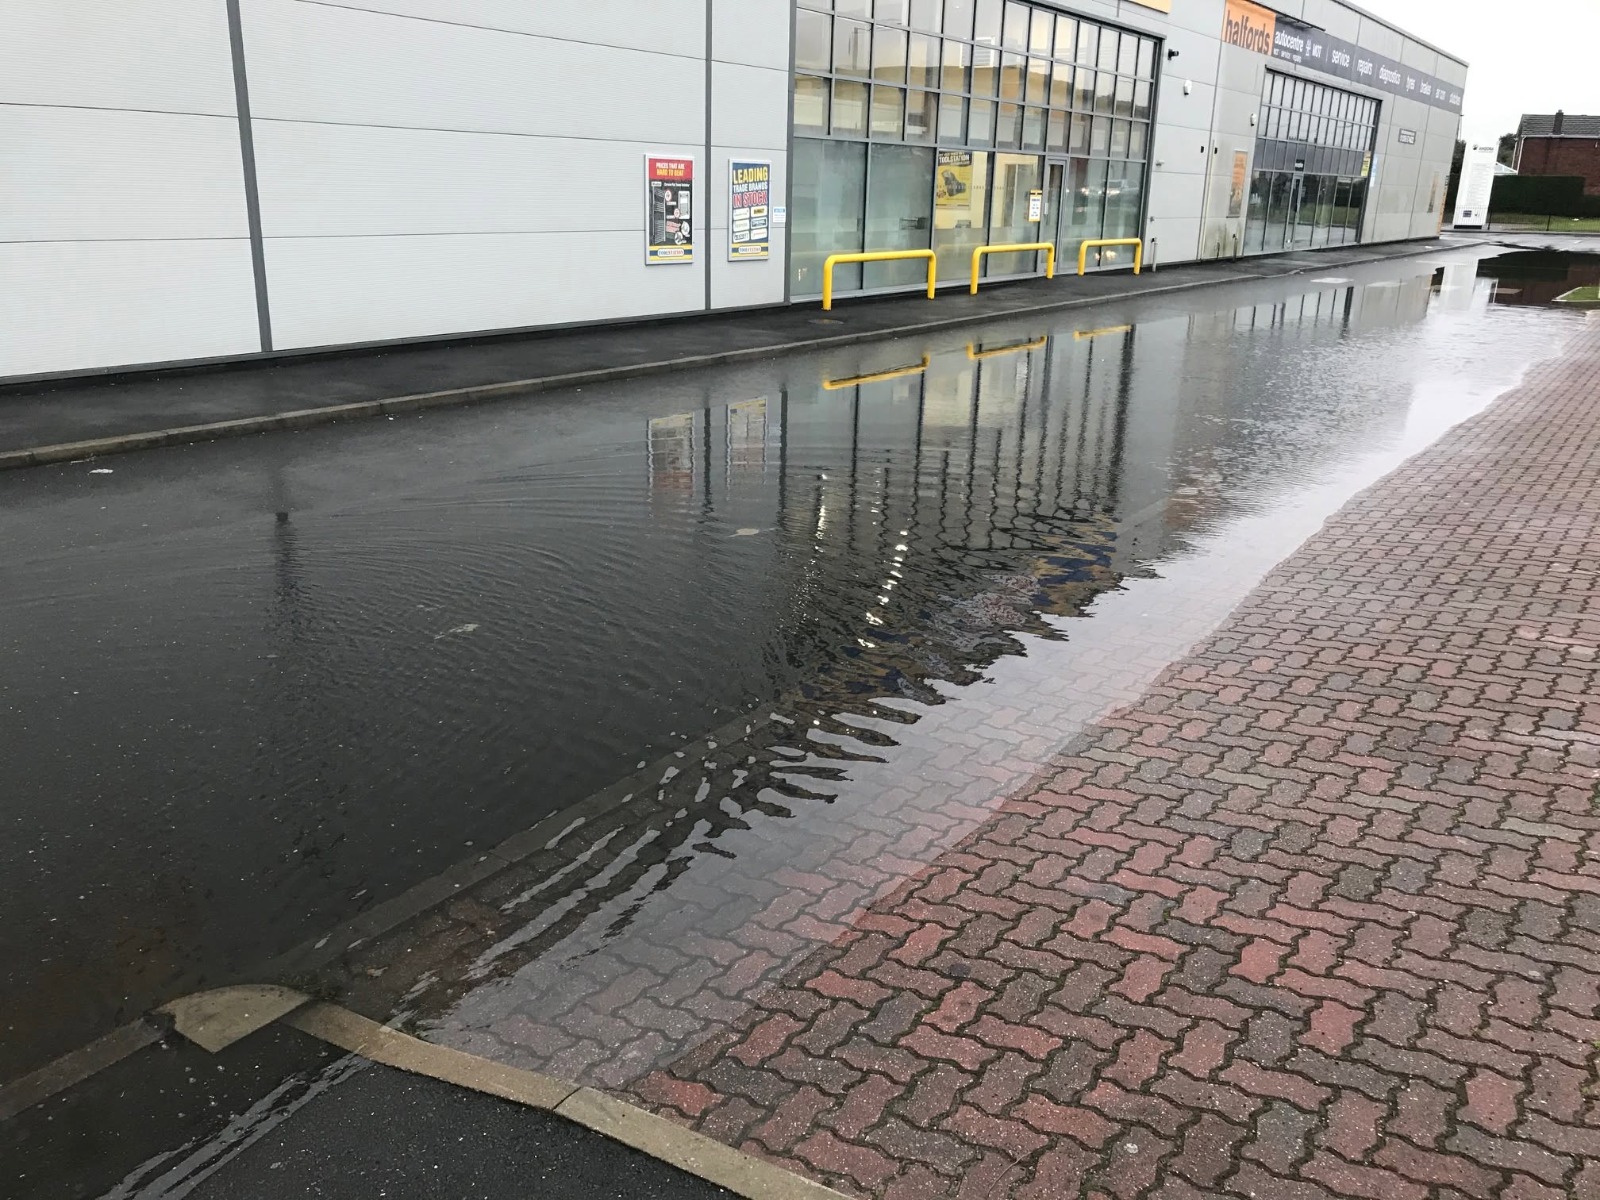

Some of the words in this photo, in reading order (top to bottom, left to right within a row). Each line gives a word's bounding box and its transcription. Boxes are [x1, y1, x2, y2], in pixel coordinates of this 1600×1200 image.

[1226, 10, 1270, 53] halfords
[1274, 30, 1304, 53] autocentre
[1312, 43, 1322, 58] MOT
[1331, 49, 1350, 67] service
[1357, 58, 1373, 76] repairs
[1379, 64, 1401, 85] diagnostics
[938, 154, 970, 163] TOOLSTATION
[656, 168, 668, 176] HARD
[733, 166, 768, 185] LEADING
[733, 183, 749, 193] TRADE
[748, 181, 768, 192] BRANDS
[733, 192, 743, 209] IN
[742, 190, 768, 208] STOCK
